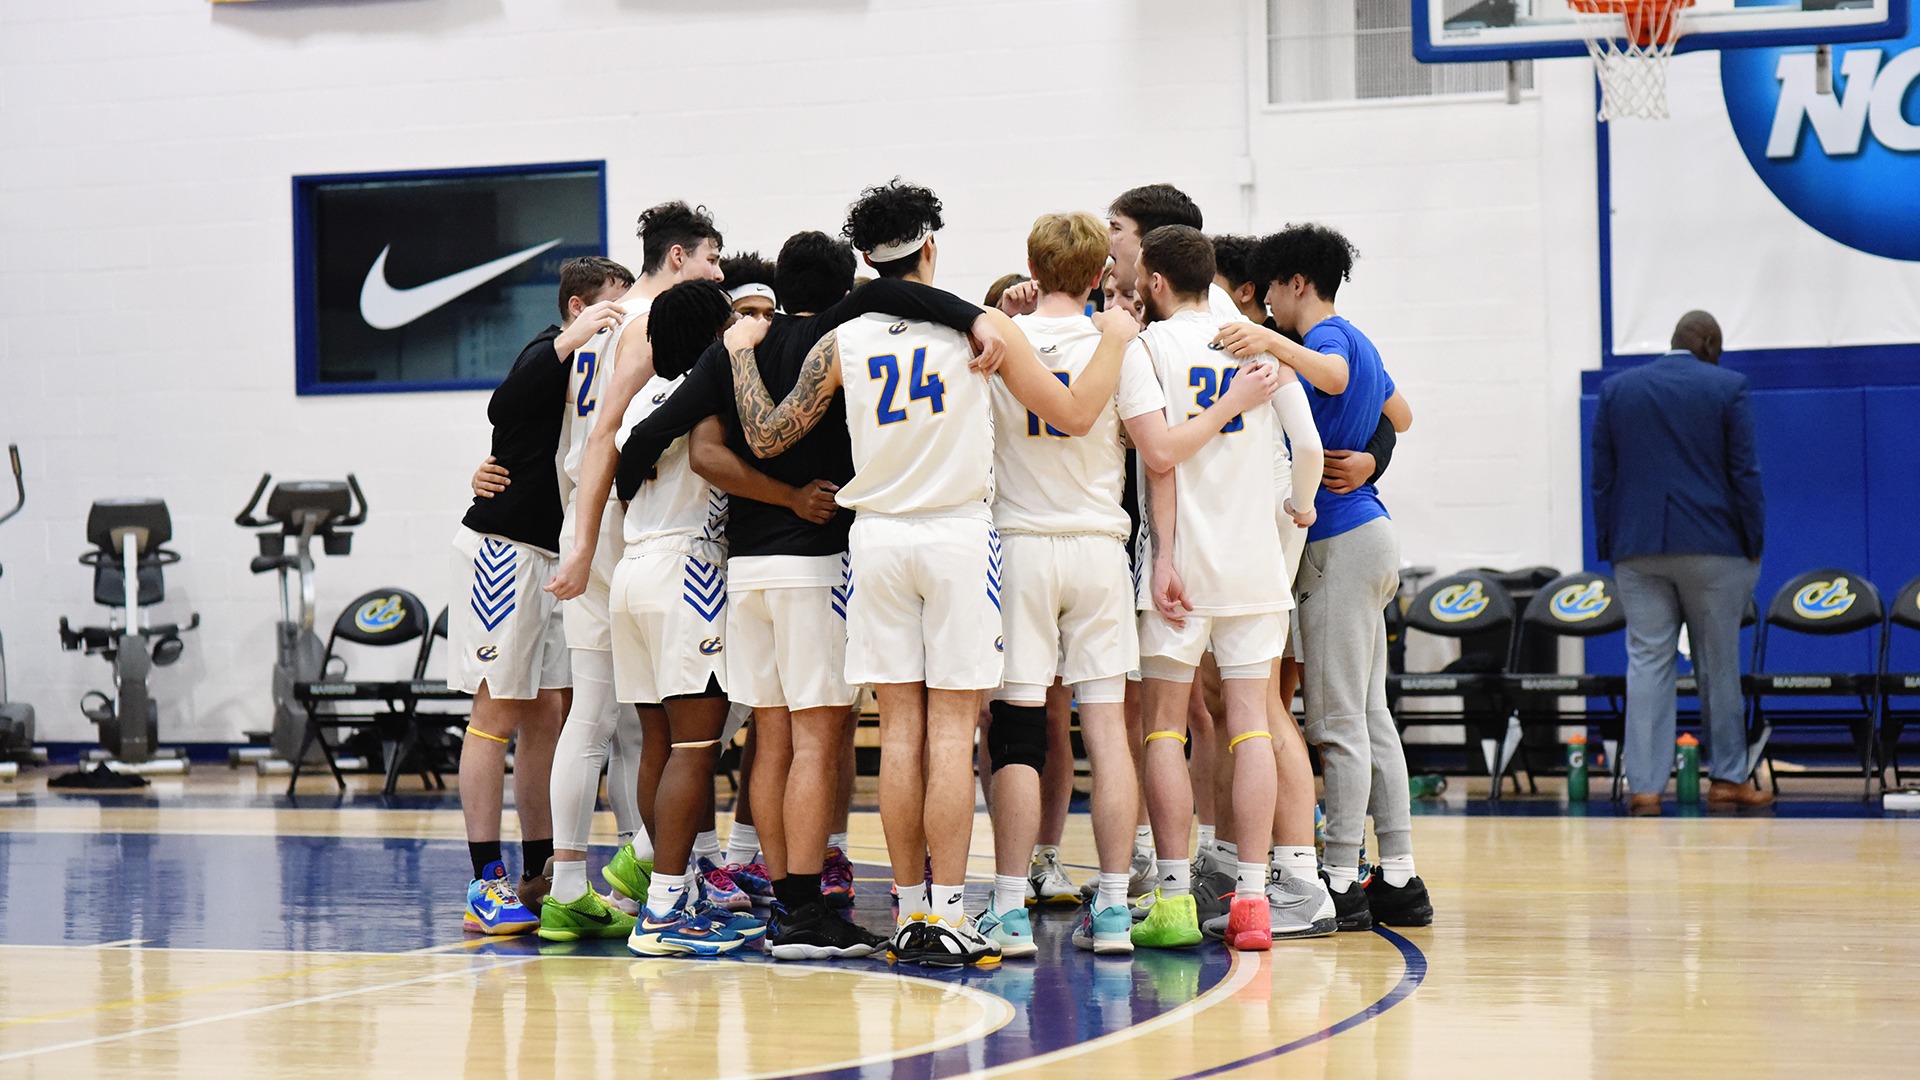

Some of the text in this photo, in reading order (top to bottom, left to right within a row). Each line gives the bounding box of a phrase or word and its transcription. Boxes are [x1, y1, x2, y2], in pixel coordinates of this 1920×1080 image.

[1766, 46, 1920, 159] NC
[576, 350, 602, 418] 2
[865, 345, 947, 428] 24
